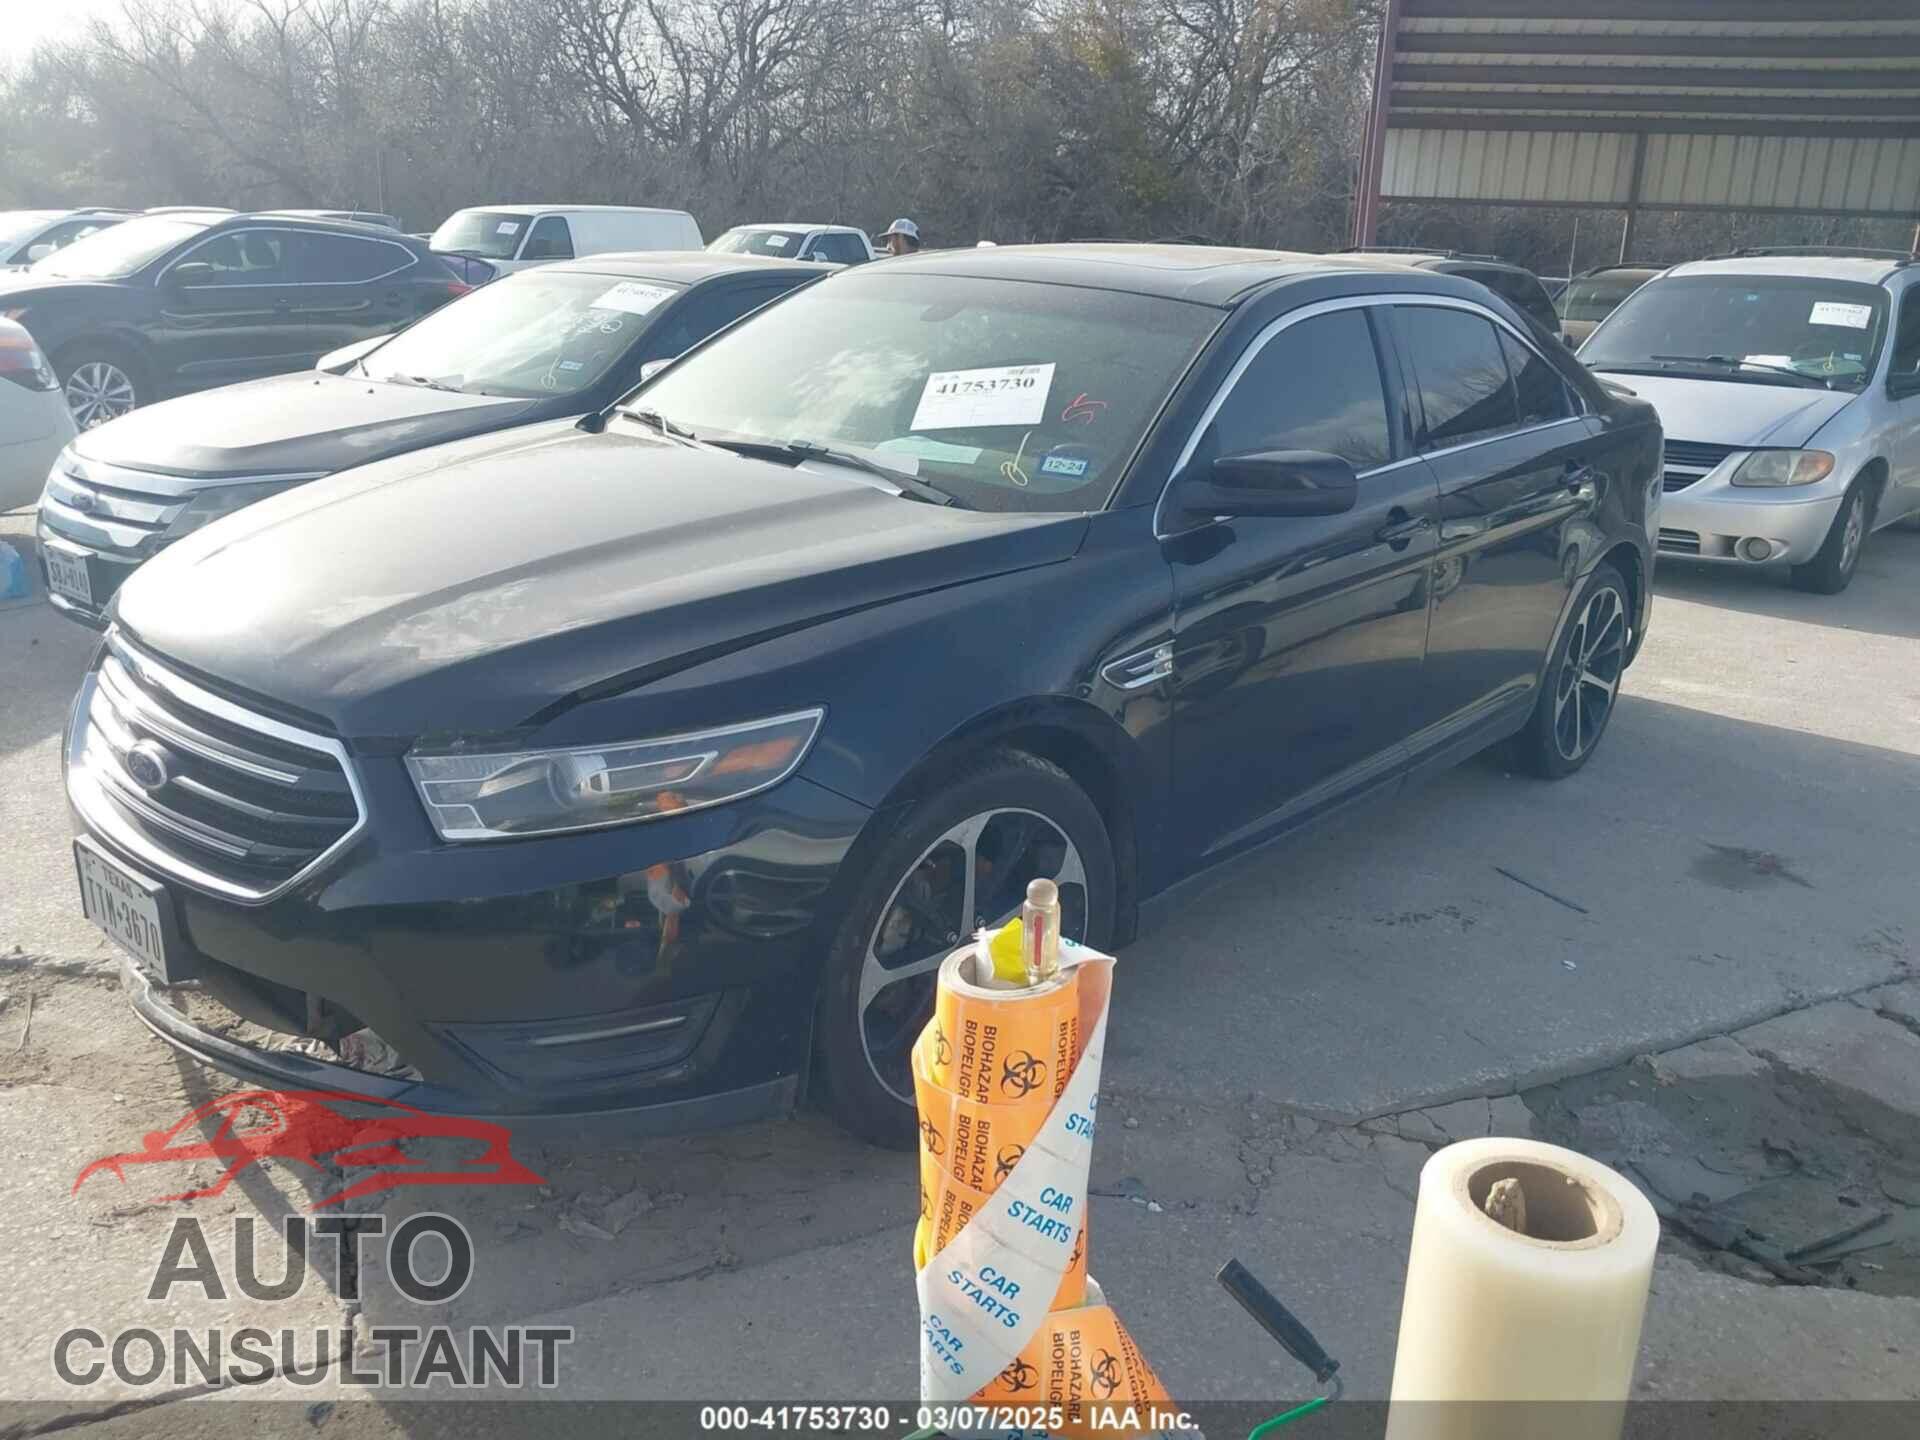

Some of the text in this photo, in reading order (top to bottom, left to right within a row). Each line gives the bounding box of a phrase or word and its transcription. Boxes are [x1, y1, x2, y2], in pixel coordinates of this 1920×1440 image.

[936, 376, 1036, 394] 41753730
[101, 864, 134, 899] TEXAS
[1054, 1021, 1068, 1099] BIOPELIG
[1040, 1186, 1074, 1214] CAR
[1007, 1200, 1072, 1244] STARTS
[947, 1270, 1021, 1328] STARTS
[978, 1266, 1021, 1300] CAR
[930, 1314, 964, 1352] CAR
